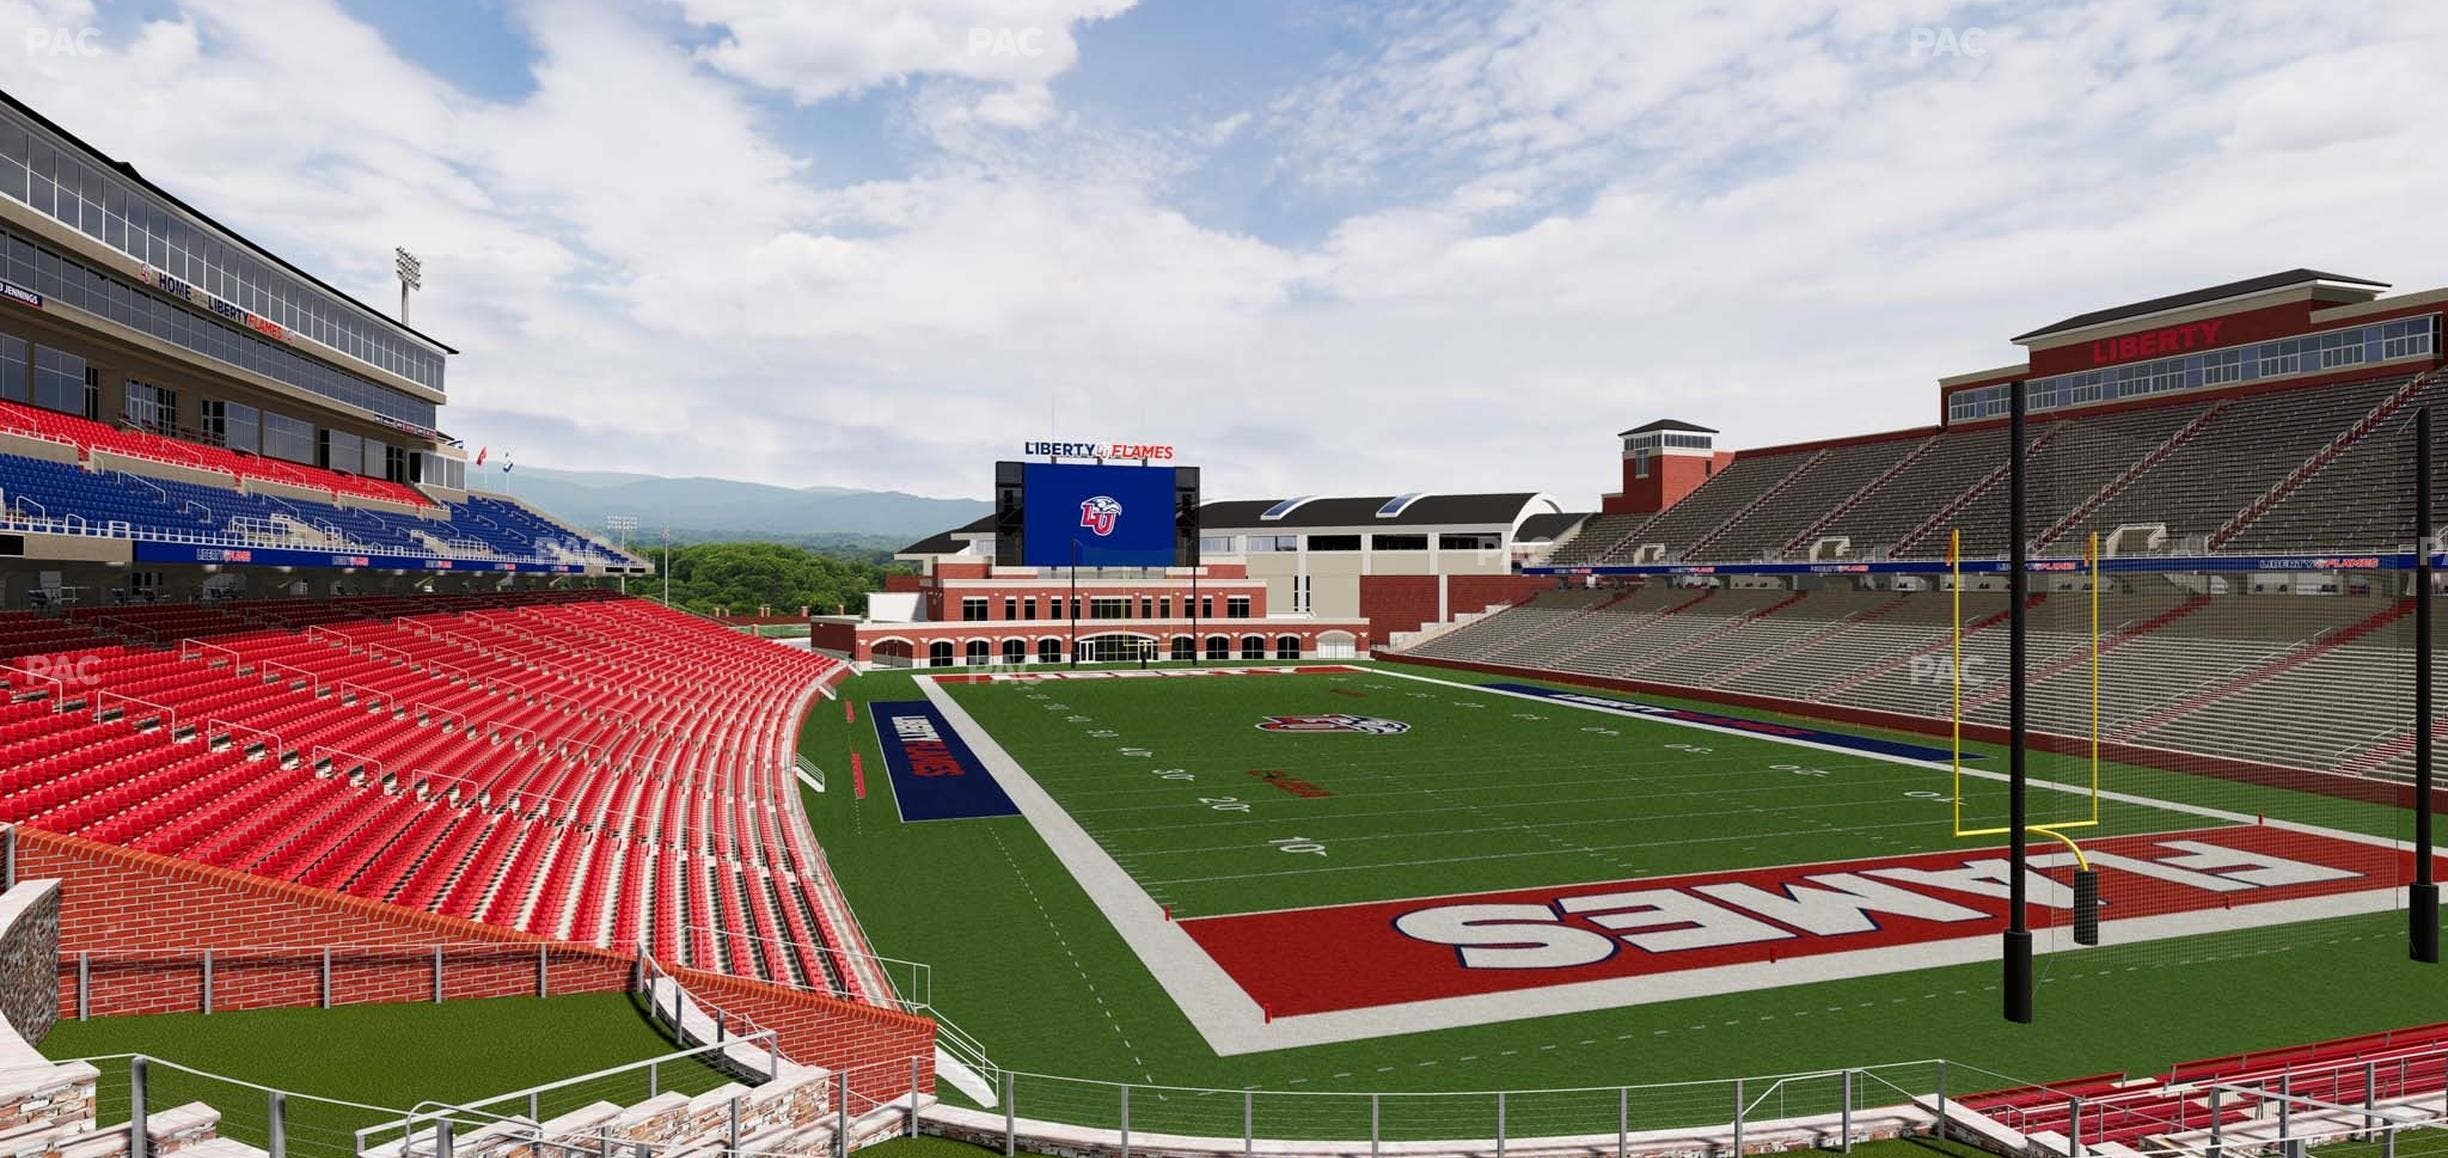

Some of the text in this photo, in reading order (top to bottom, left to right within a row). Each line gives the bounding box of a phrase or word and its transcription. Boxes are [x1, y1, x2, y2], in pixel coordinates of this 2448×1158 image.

[4, 284, 38, 304] JENNINGS
[158, 272, 192, 300] HOME
[2092, 321, 2223, 364] LIBERTY
[1025, 441, 1095, 456] LIBERTY
[1111, 444, 1173, 459] FLAMES
[1198, 796, 1251, 813] 20
[1268, 836, 1328, 857] 10
[1392, 838, 2366, 970] FLAMES
